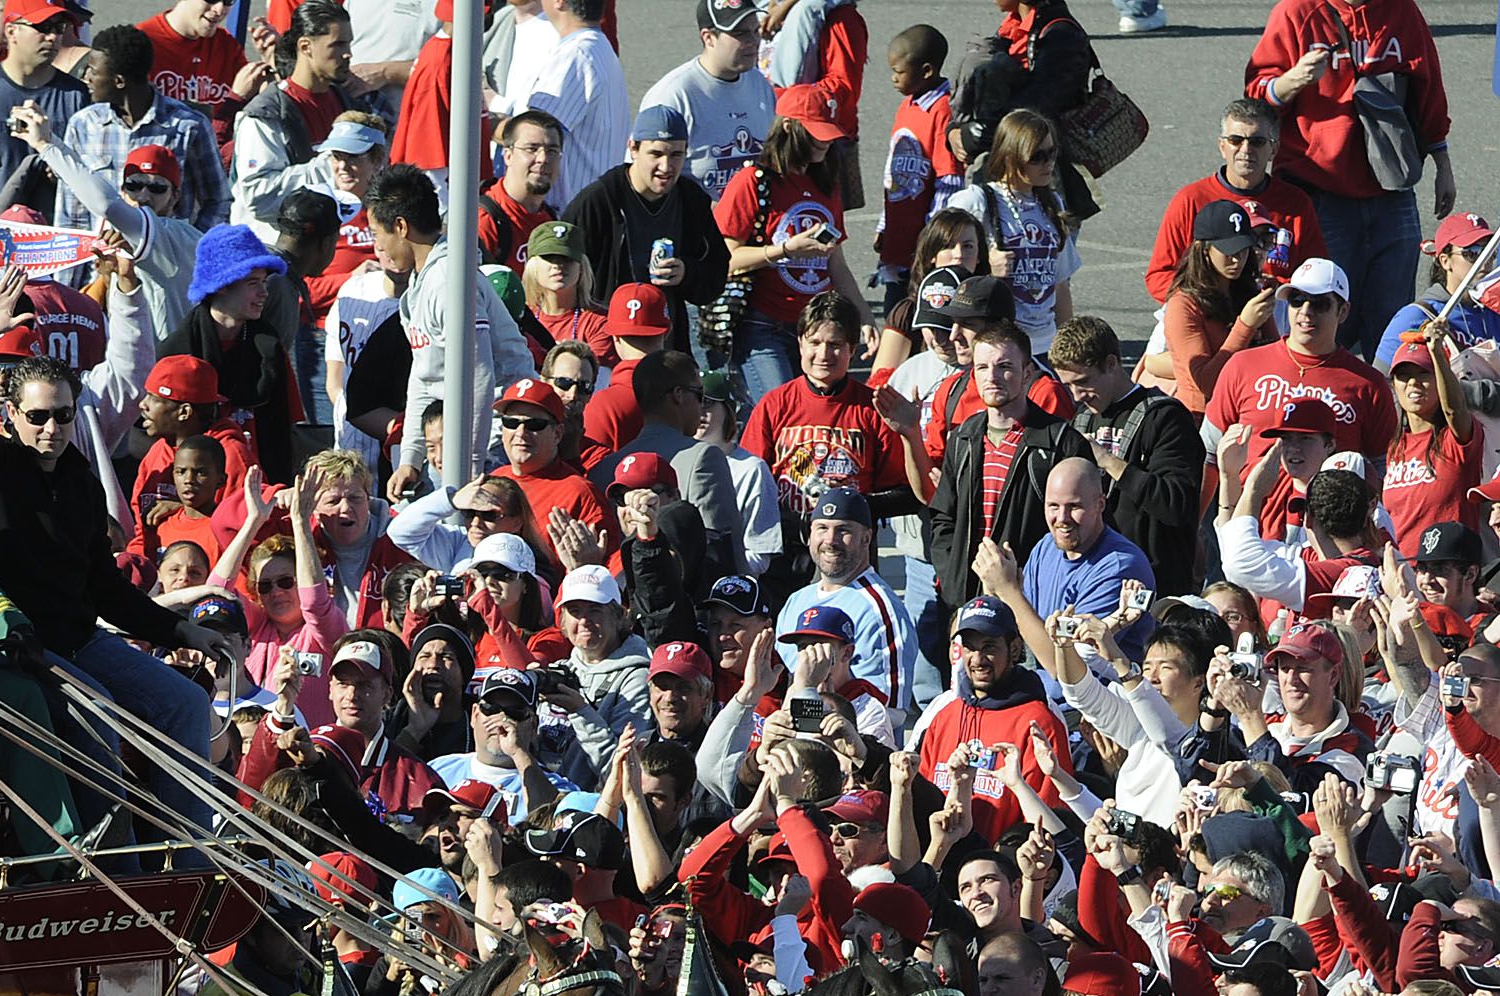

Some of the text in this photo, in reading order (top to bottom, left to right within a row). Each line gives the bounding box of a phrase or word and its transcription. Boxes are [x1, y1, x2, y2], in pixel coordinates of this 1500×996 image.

[155, 70, 231, 105] Phillies
[1229, 212, 1244, 232] P
[552, 225, 567, 239] P
[14, 250, 78, 264] CHAMPIONS
[626, 299, 642, 320] P
[515, 378, 534, 398] P
[1283, 403, 1297, 422] P
[621, 456, 636, 473] P
[803, 607, 820, 626] P
[666, 643, 684, 661] P
